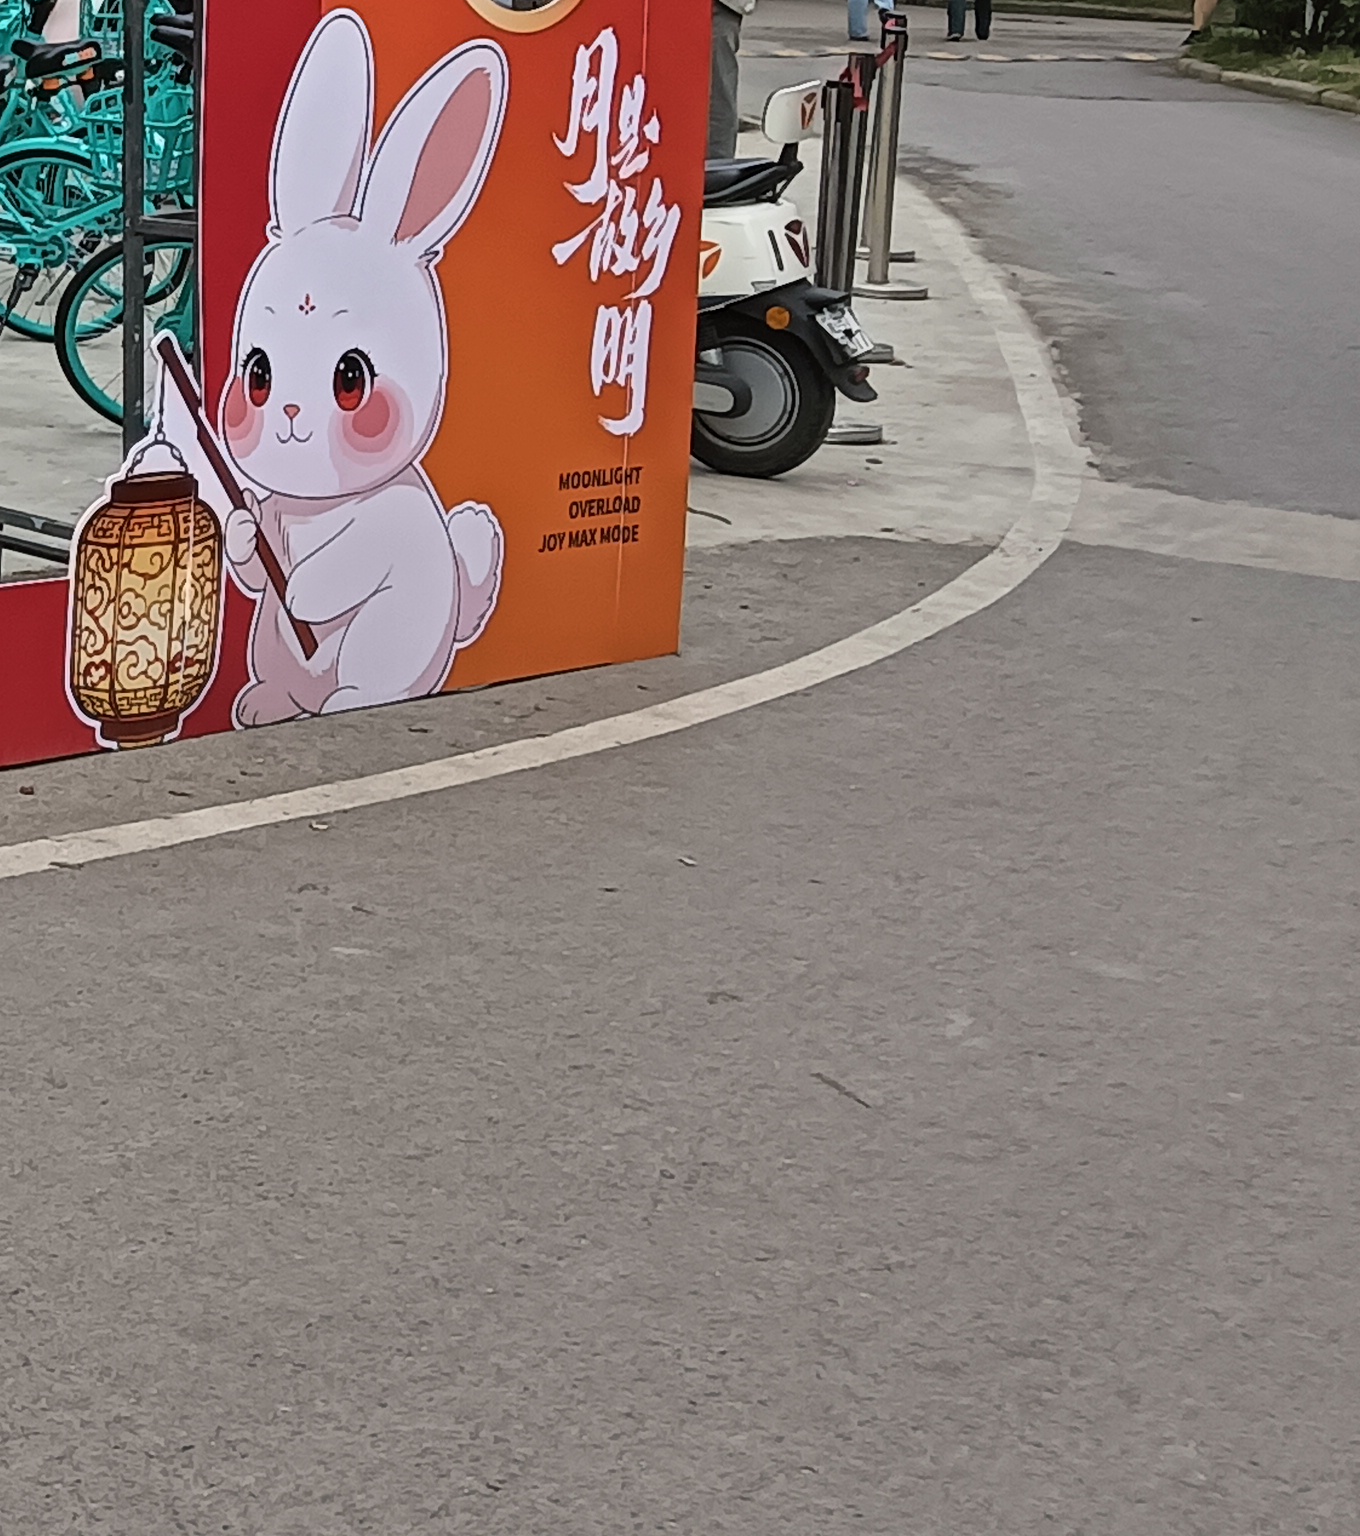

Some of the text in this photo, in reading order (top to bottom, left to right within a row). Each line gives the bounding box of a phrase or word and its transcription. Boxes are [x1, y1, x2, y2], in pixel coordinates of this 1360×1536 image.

[558, 466, 644, 491] MOONLIGHT
[568, 495, 641, 520] OVERLOAD
[537, 524, 640, 553] JOY MAX MODE
